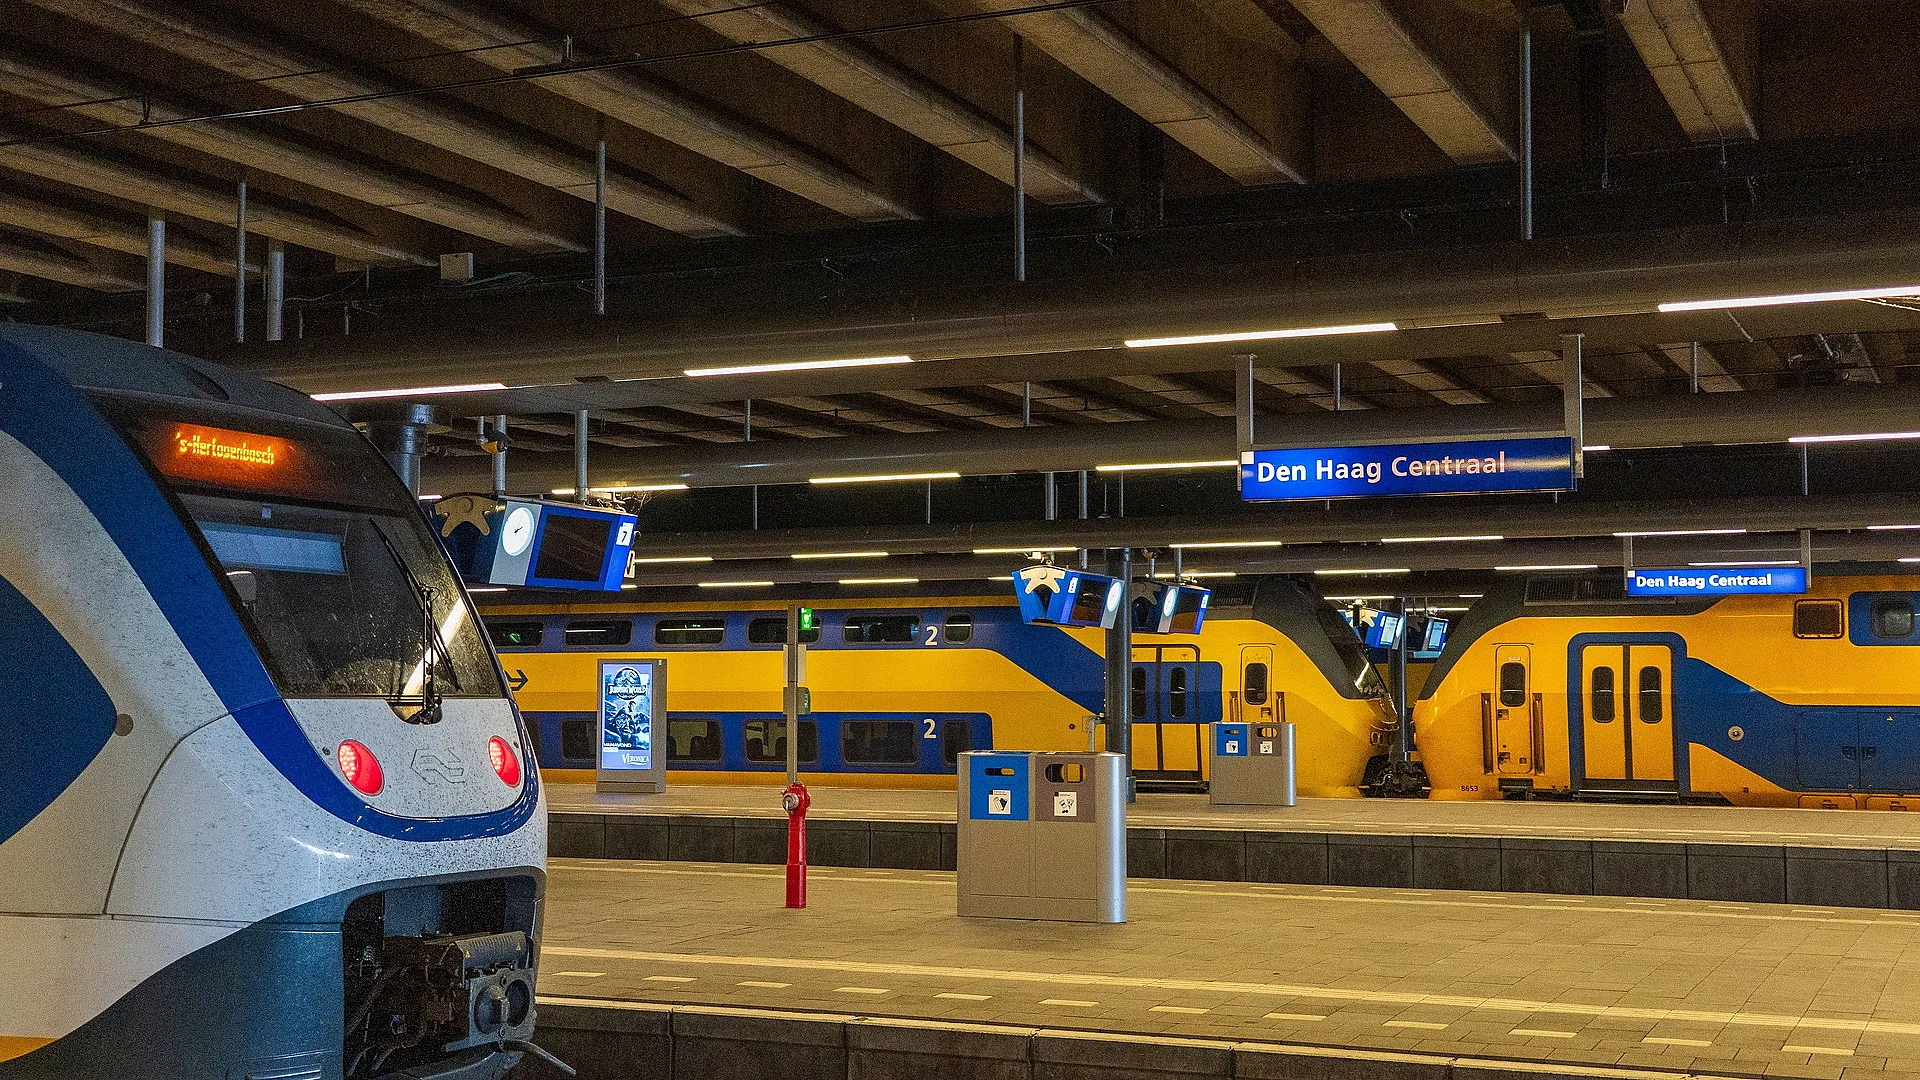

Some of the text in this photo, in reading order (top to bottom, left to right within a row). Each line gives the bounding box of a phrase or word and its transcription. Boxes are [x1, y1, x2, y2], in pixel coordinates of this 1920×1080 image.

[175, 432, 275, 465] 's-Hertogenbosch
[1257, 450, 1505, 484] Den Haag Centraal
[622, 530, 628, 543] 7
[1636, 573, 1772, 590] Den Haag Centraal
[925, 625, 938, 646] 2
[923, 718, 937, 739] 2
[621, 752, 650, 765] VERONICA
